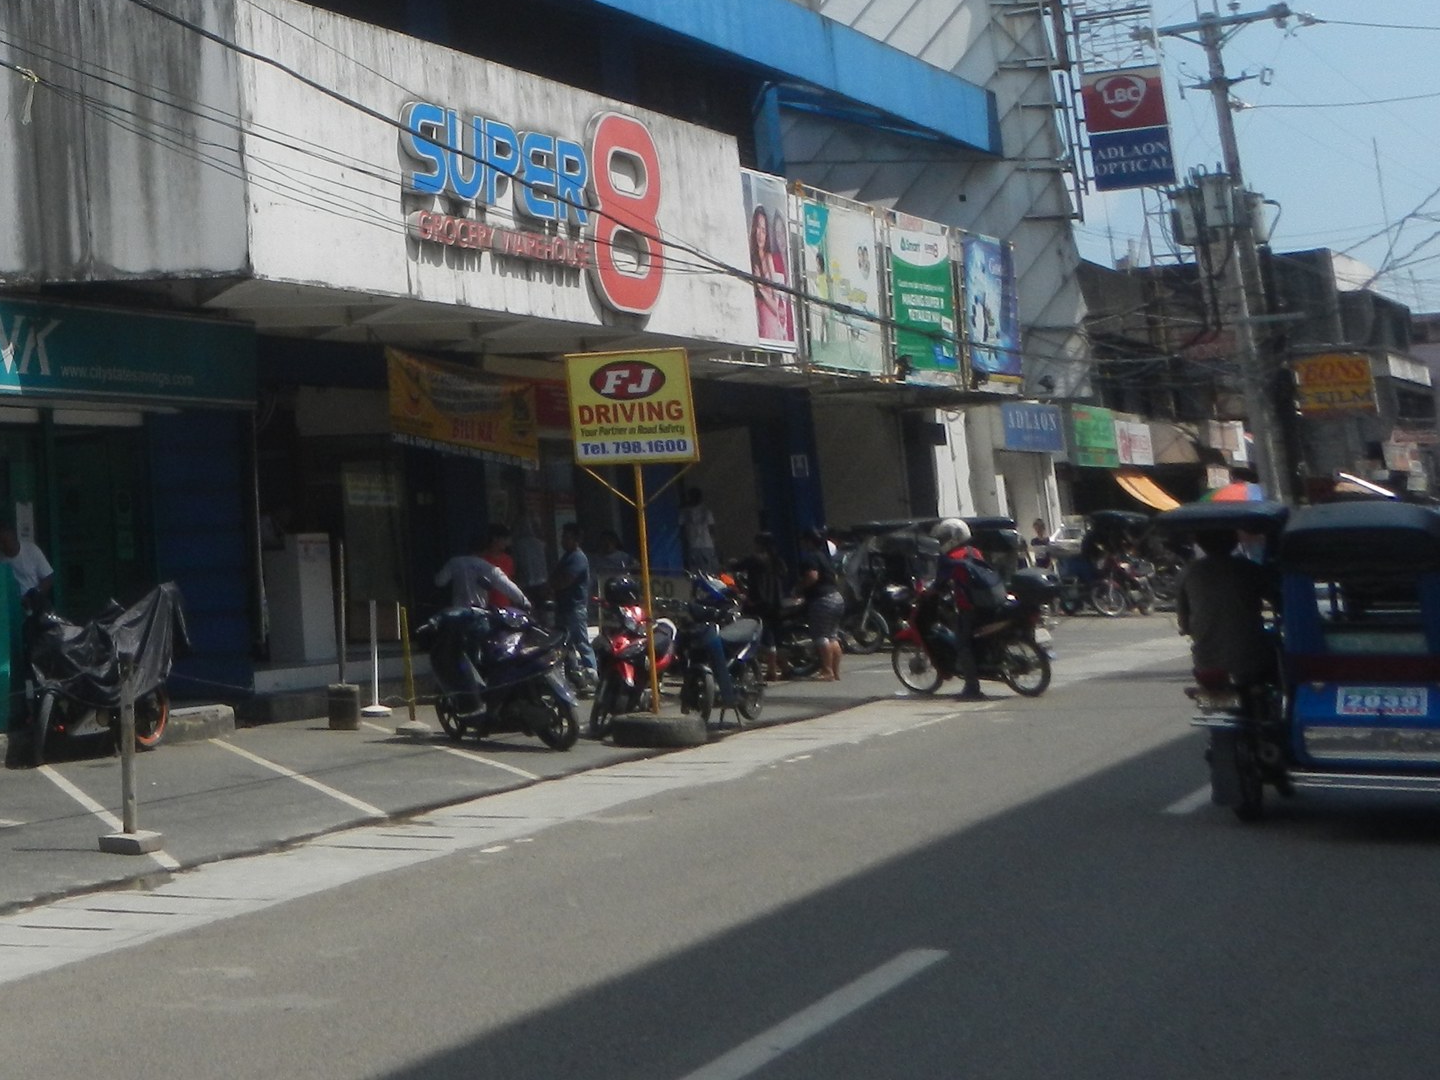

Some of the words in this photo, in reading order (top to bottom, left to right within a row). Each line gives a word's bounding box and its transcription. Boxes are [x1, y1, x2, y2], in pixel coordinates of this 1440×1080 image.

[1103, 86, 1141, 104] LBC
[1095, 157, 1171, 176] OPTICAL
[409, 102, 589, 226] SUPER
[592, 111, 664, 315] 8
[601, 368, 655, 393] FJ
[578, 400, 684, 425] DRIVING
[581, 442, 609, 455] Tel.
[612, 439, 687, 454] 798.1600
